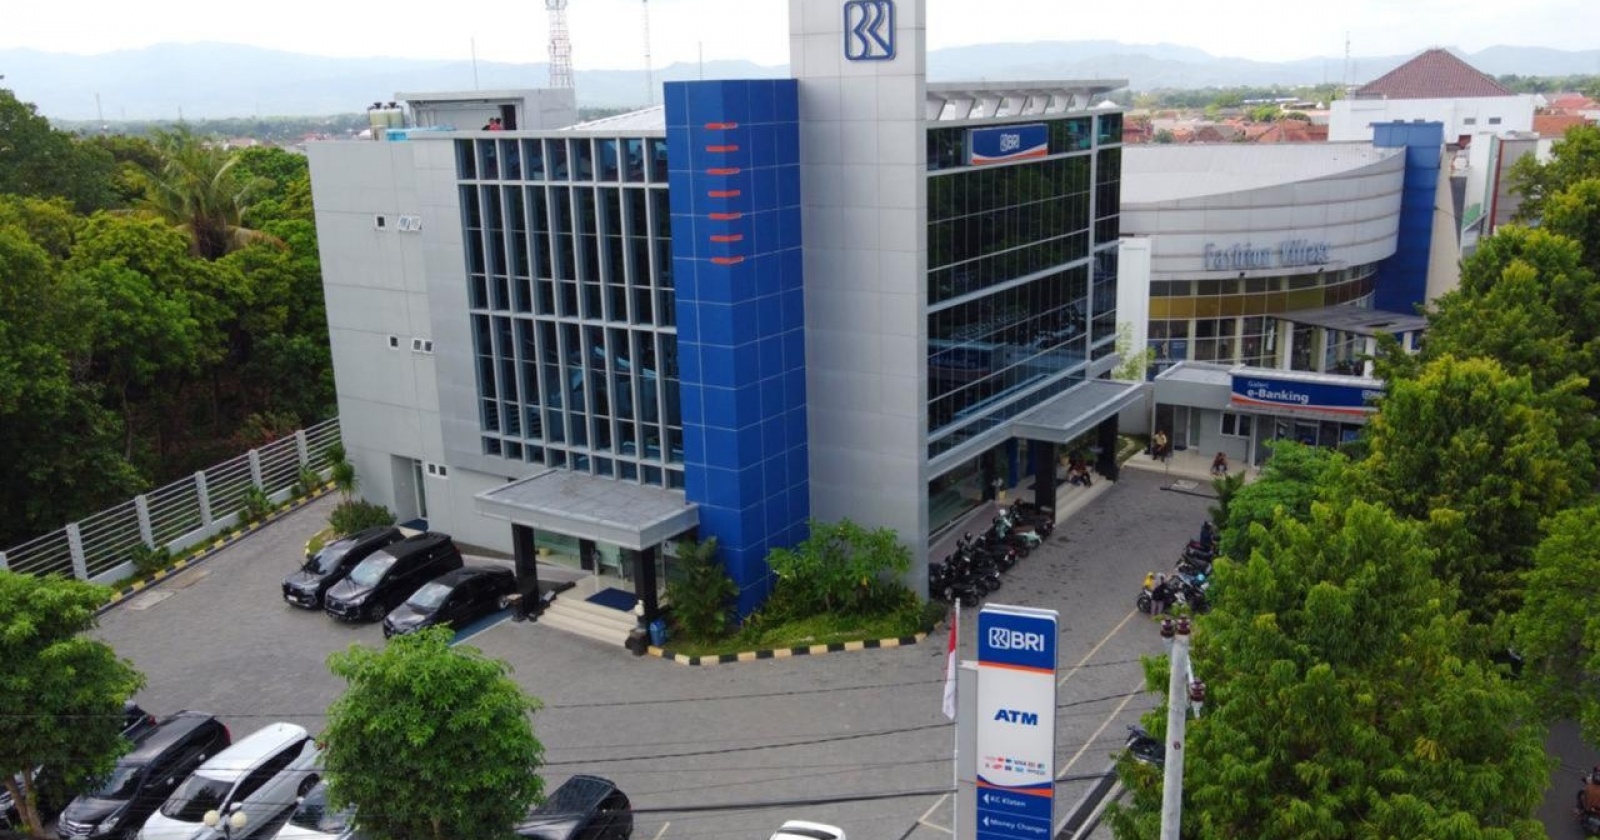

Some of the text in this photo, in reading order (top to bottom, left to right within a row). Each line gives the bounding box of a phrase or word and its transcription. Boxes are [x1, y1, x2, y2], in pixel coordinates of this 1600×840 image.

[1247, 389, 1309, 405] e-Banking
[1010, 630, 1045, 652] BRI
[994, 709, 1038, 726] ATM
[989, 818, 1048, 834] Money Changer
